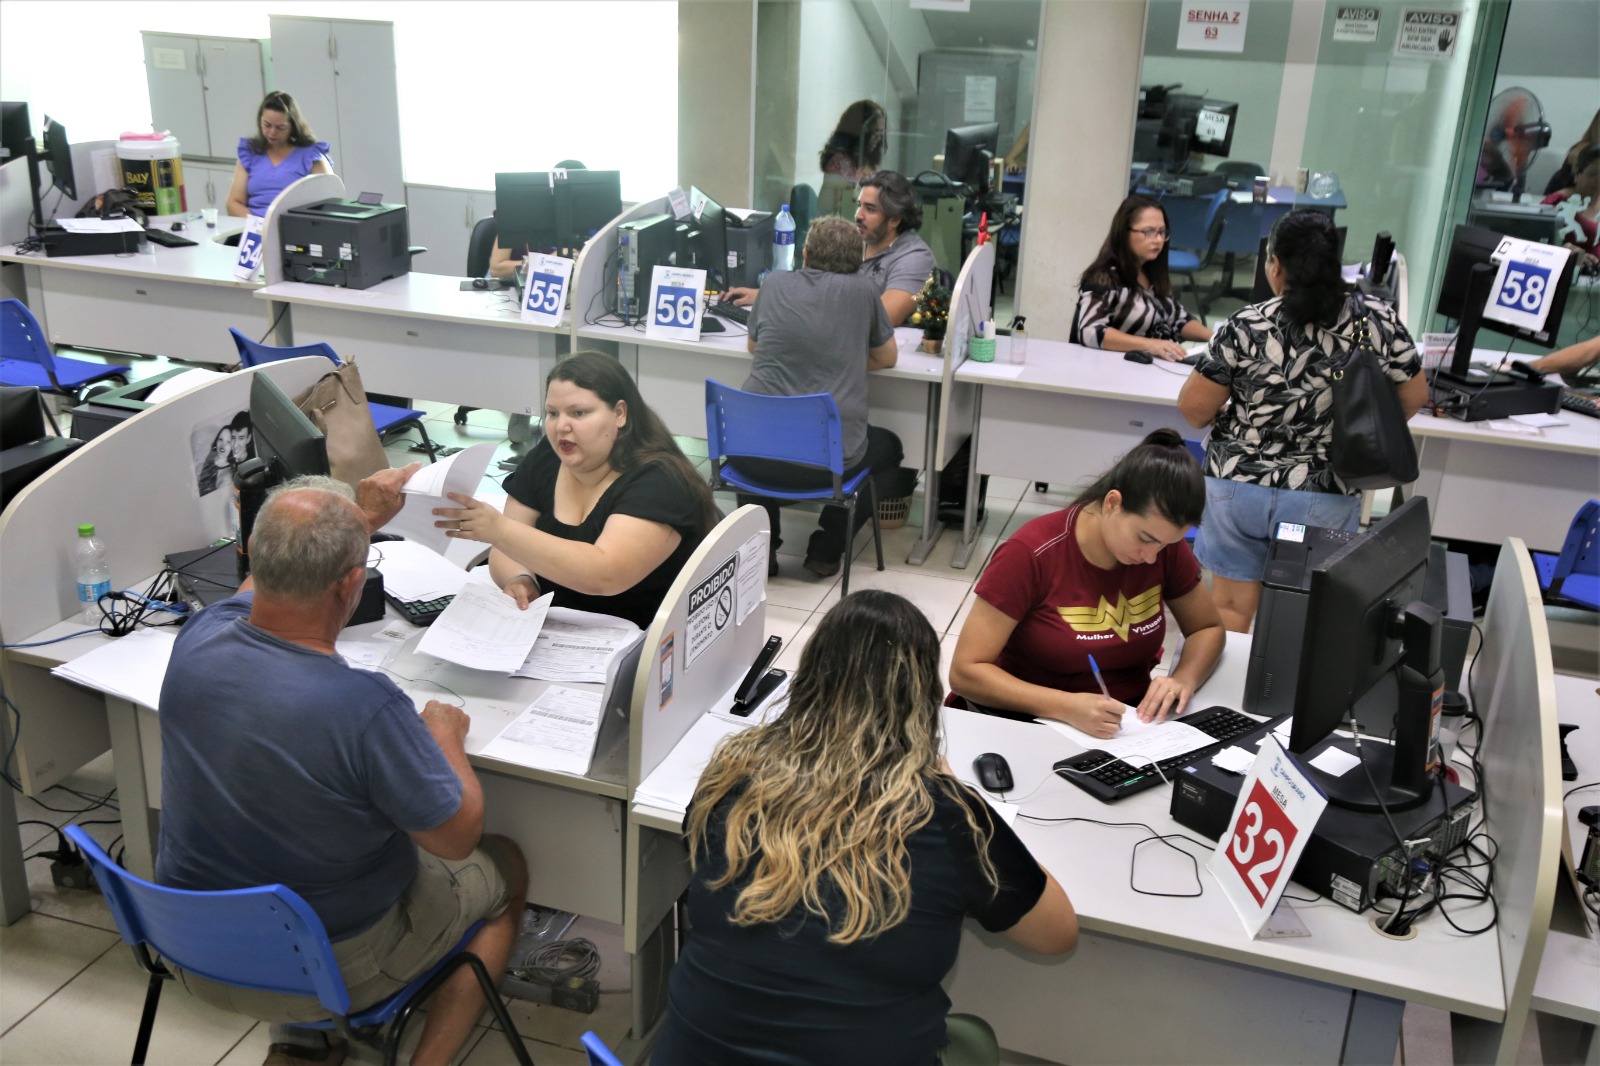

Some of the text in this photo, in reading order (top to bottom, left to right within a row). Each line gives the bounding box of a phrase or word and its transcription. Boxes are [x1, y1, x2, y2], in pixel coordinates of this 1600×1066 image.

[1187, 9, 1240, 22] SENHA Z
[1342, 9, 1375, 19] AVISO
[1410, 12, 1454, 24] AVISO
[1204, 26, 1218, 38] 63
[1204, 113, 1225, 123] MESA
[240, 239, 263, 267] 54
[529, 280, 562, 312] 55
[1501, 269, 1545, 311] 58
[656, 293, 695, 325] 56
[690, 562, 735, 611] PROIBIDO
[1076, 633, 1115, 641] Mulher
[1272, 785, 1288, 809] MESA
[1233, 801, 1285, 900] 32
